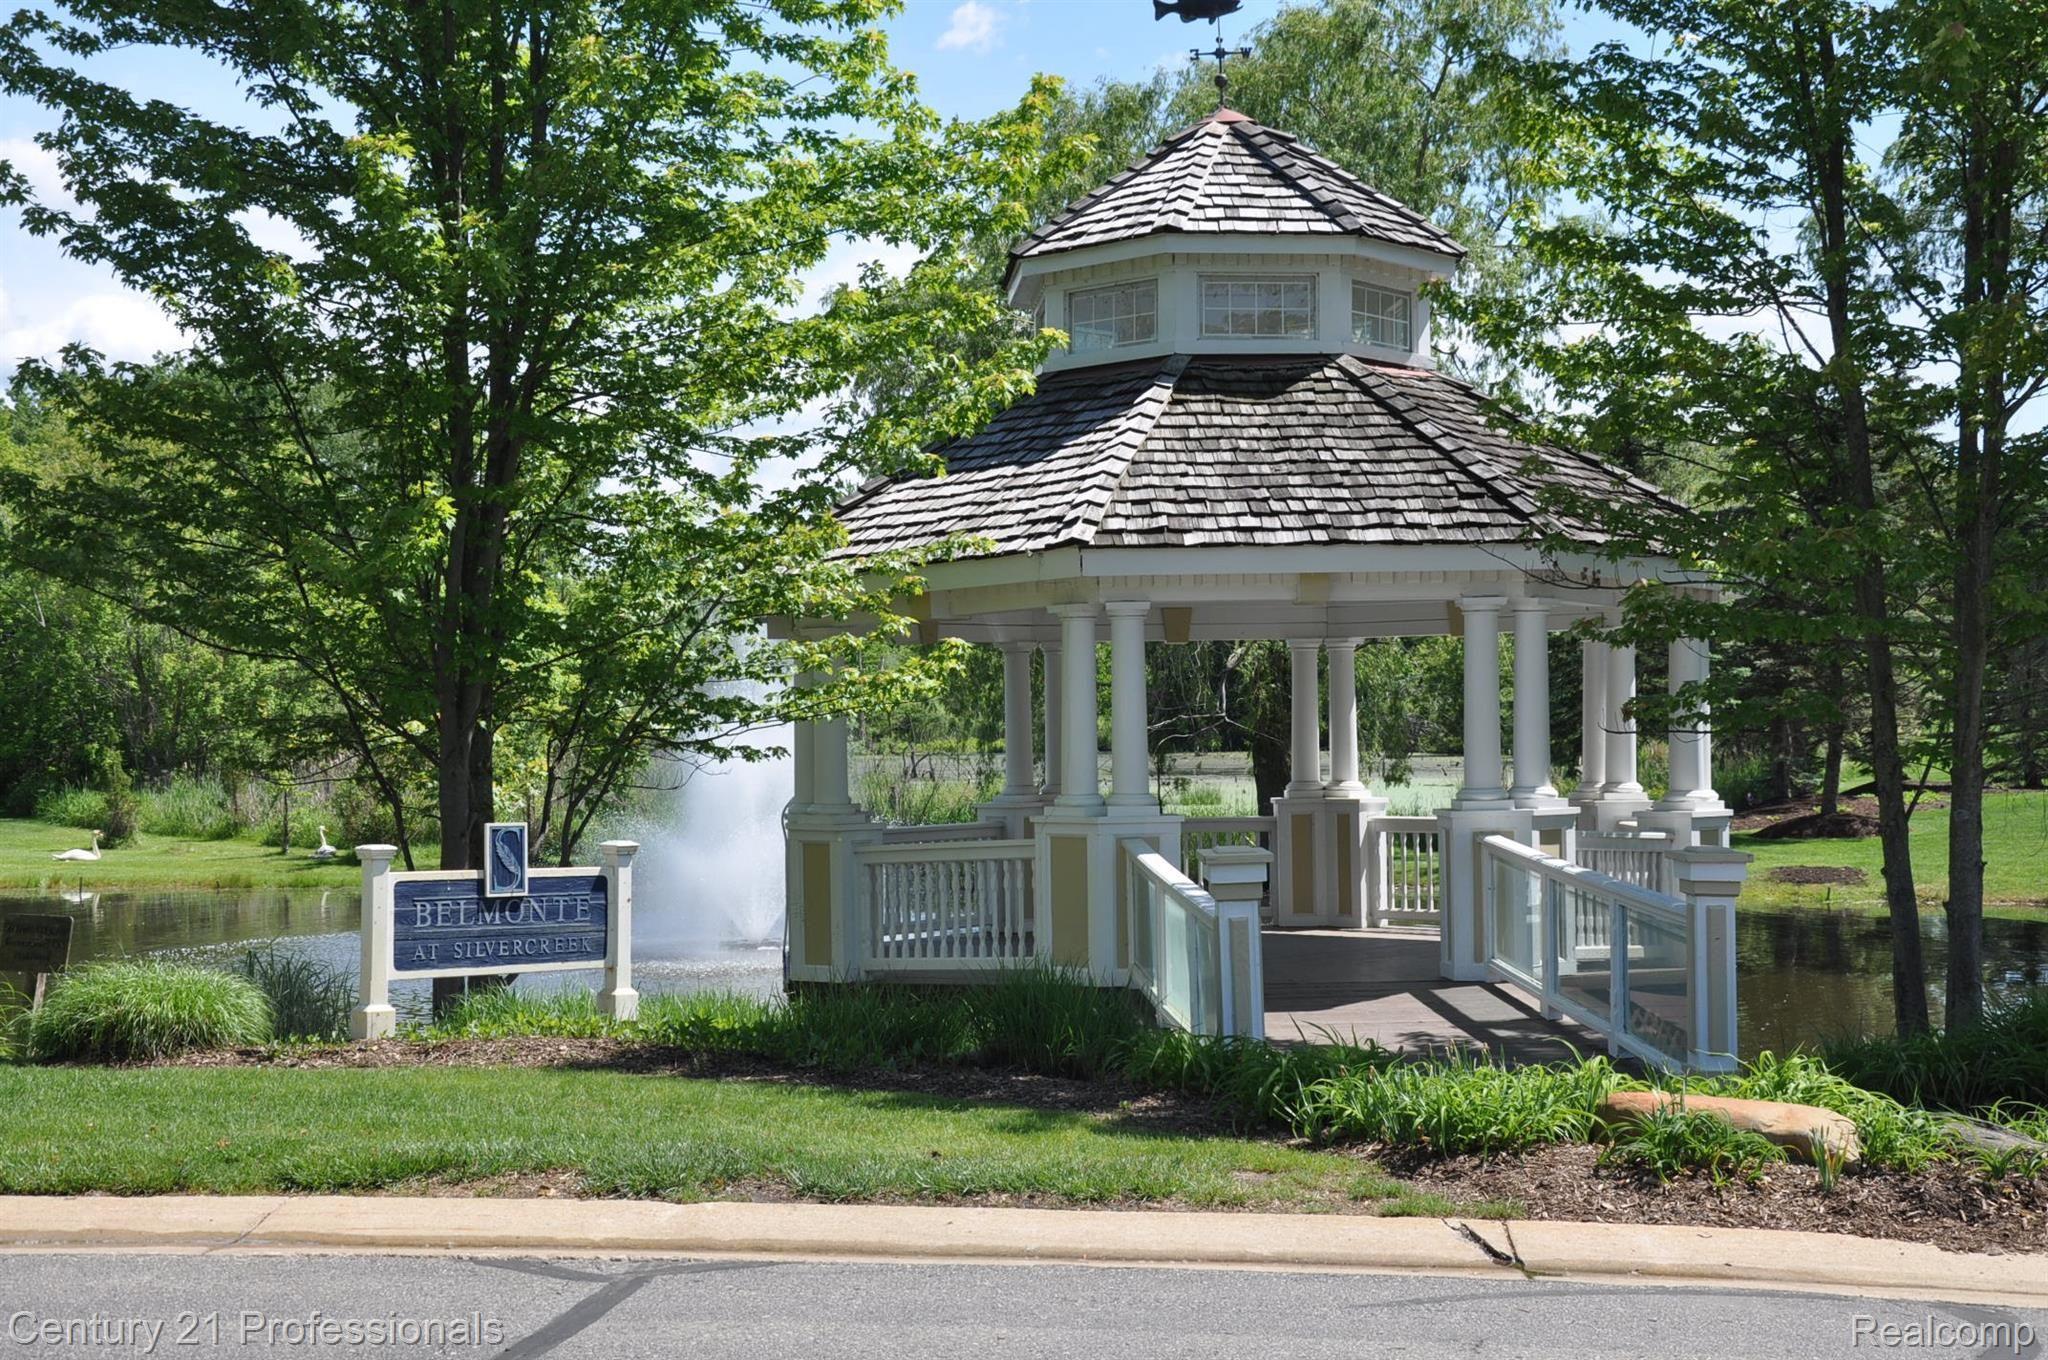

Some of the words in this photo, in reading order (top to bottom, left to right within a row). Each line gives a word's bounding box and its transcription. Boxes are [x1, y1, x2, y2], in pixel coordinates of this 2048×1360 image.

[413, 896, 592, 928] BELMONTE
[412, 944, 440, 961] AT
[454, 936, 593, 959] SILVERCREEK
